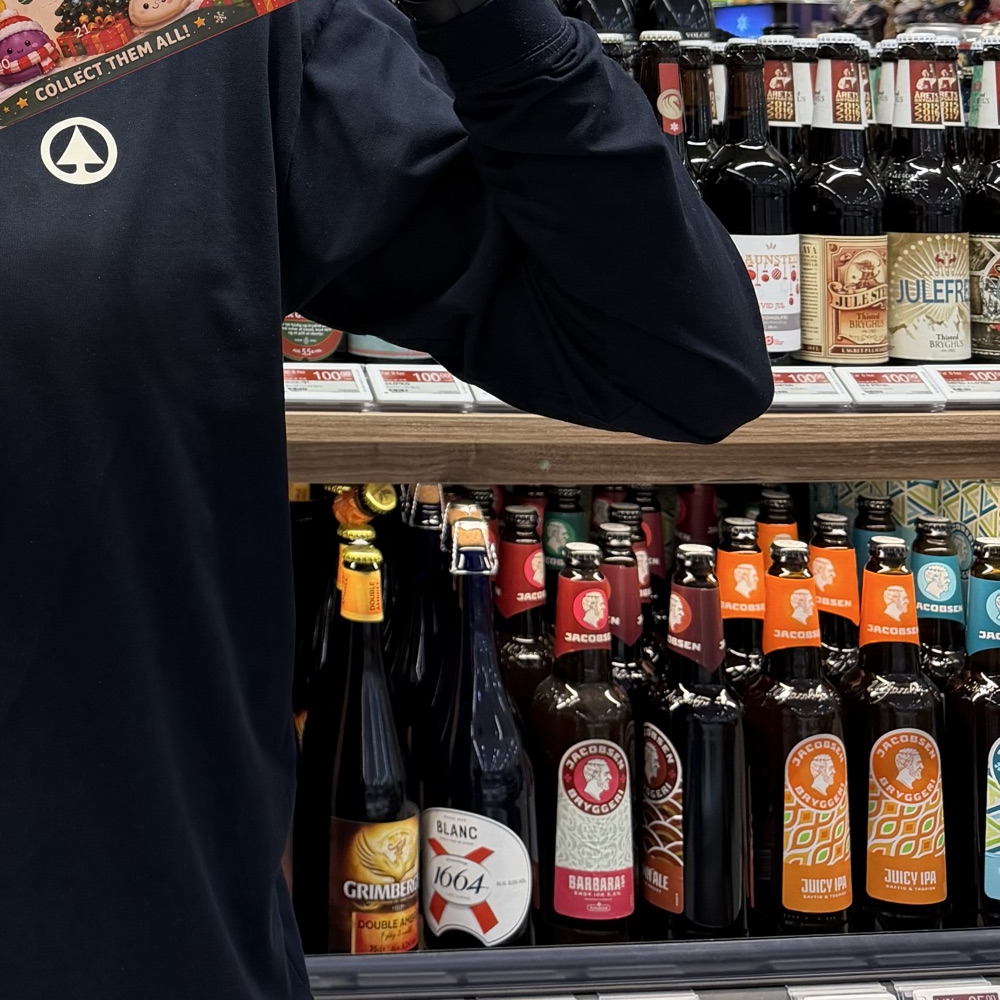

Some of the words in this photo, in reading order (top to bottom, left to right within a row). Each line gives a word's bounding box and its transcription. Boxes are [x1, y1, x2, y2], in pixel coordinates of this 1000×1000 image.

[73, 24, 91, 39] 21
[35, 62, 103, 102] COLLECT
[104, 42, 153, 75] THEM
[156, 24, 192, 51] ALL!
[836, 293, 869, 308] JULE
[849, 320, 885, 329] BRYGHUS
[856, 313, 880, 321] Thisted
[929, 340, 965, 349] BRYGHUS
[313, 370, 341, 381] 100
[412, 372, 440, 382] 100
[788, 373, 816, 383] 100
[882, 373, 909, 383] 100
[969, 371, 997, 381] 100
[792, 740, 845, 767] JACOBSEN
[876, 734, 936, 760] JACOBSEN
[567, 744, 625, 770] JACOBSEN
[794, 782, 845, 809] BRYGGERI
[878, 778, 937, 802] BRYGGERI
[567, 788, 625, 814] BRYGGERI
[436, 820, 478, 840] BLANC
[434, 866, 488, 894] 1664
[801, 878, 834, 893] JUICY
[834, 875, 848, 891] IPA
[884, 868, 918, 885] JUICY
[920, 870, 937, 885] IPA
[358, 918, 398, 930] DOUBLE
